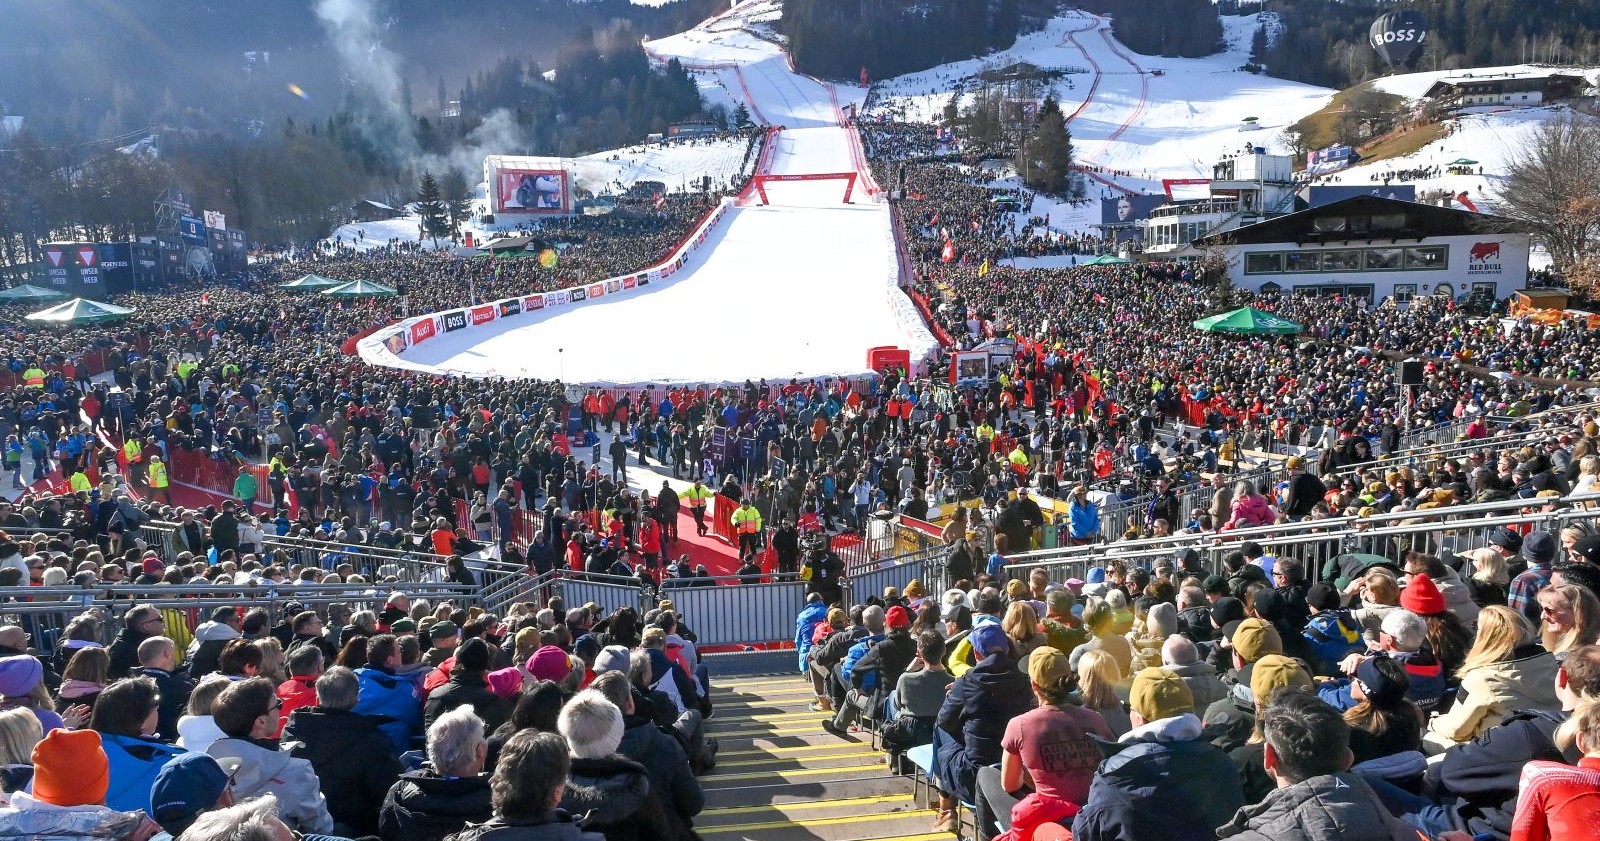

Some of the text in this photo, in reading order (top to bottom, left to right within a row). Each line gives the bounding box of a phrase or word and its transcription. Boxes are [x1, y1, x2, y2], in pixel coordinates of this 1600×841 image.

[1375, 29, 1415, 45] BOSS
[49, 268, 67, 276] UNSER
[81, 267, 98, 275] UNSER
[52, 277, 67, 285] HEER
[84, 276, 98, 284] HEER
[447, 315, 463, 328] BOSS
[416, 323, 430, 338] Audi
